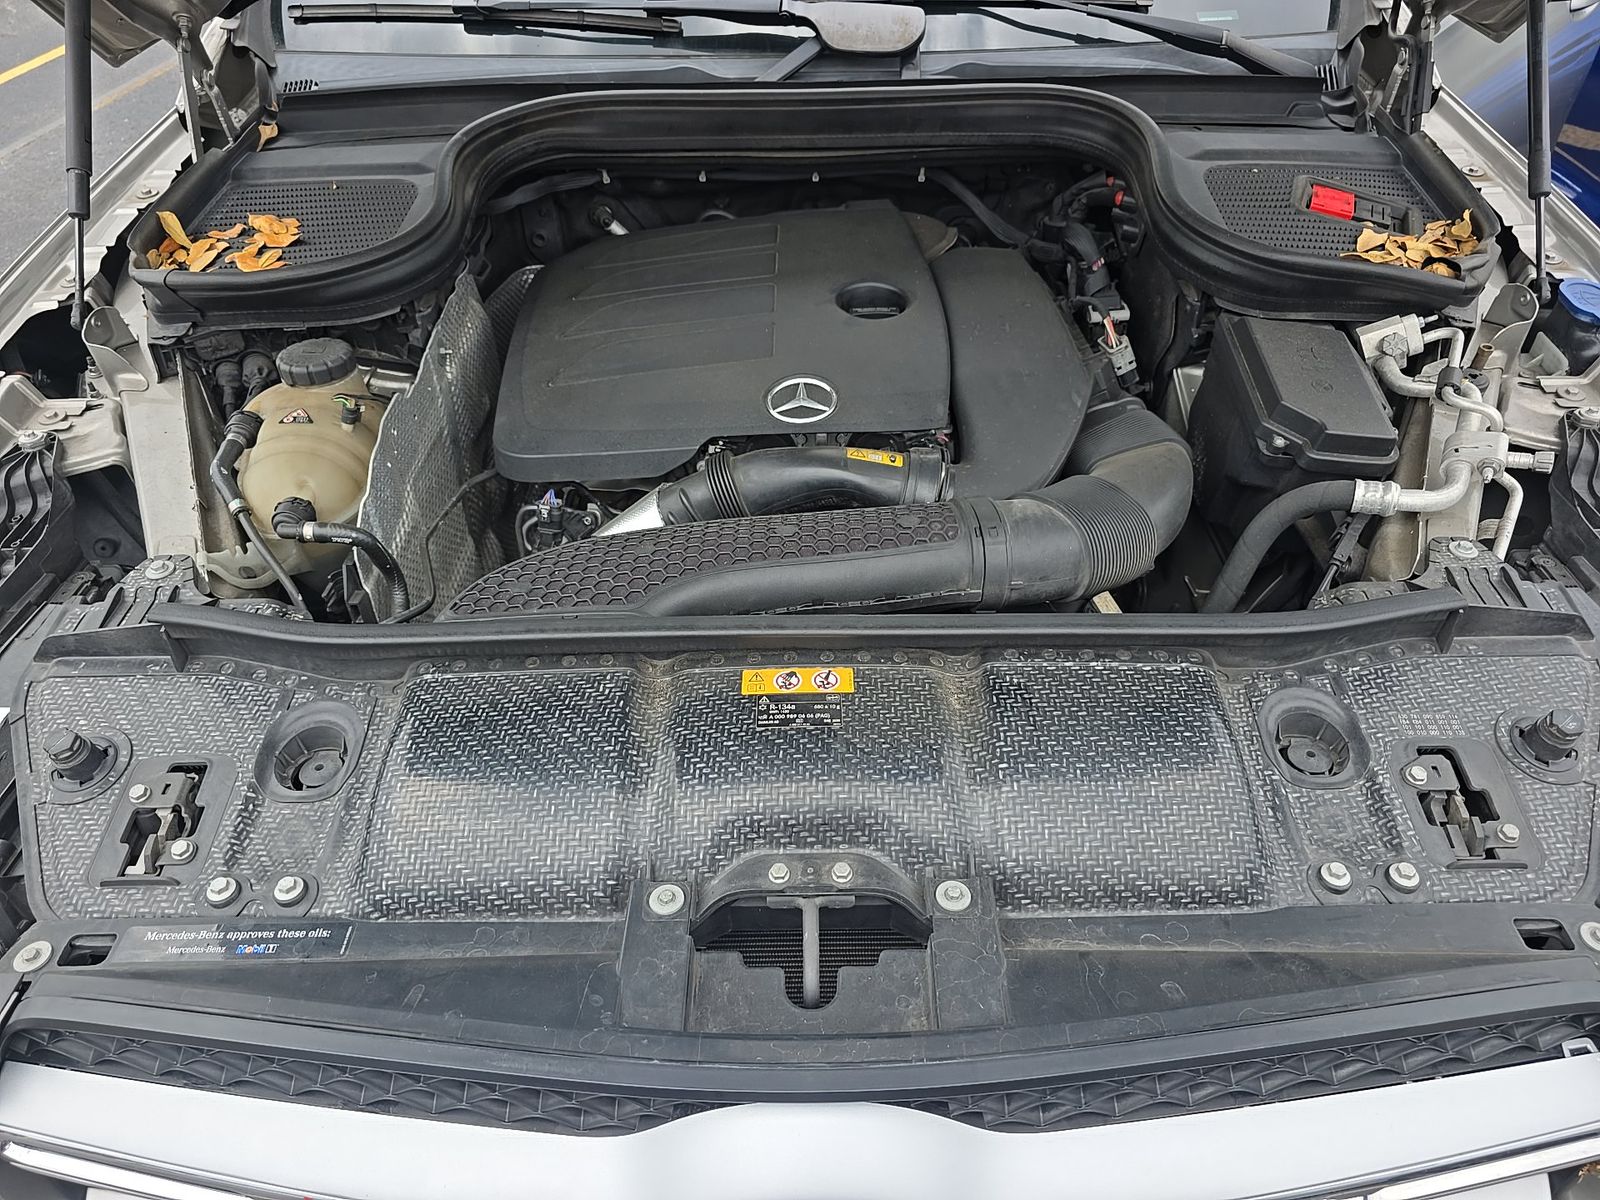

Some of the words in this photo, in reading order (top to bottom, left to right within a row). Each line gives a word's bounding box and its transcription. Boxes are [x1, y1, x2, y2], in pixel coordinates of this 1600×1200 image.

[144, 930, 225, 940] Mercedes-Benz
[226, 930, 276, 940] approves
[277, 929, 306, 938] these
[308, 928, 332, 938] oils:
[166, 945, 227, 954] Mercedes-Benz
